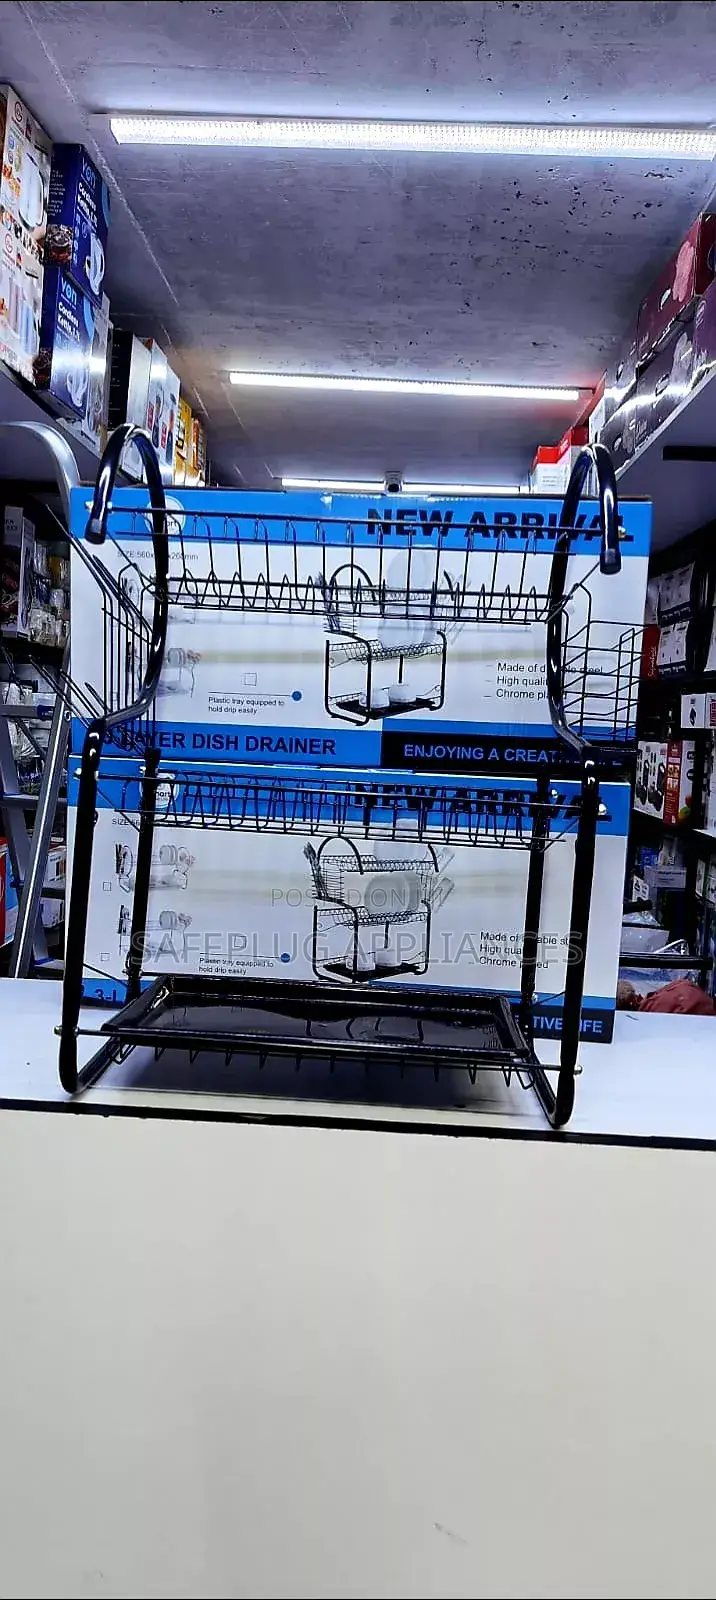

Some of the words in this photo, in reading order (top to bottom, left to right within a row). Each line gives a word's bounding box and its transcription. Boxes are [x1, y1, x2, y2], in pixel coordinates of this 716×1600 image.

[61, 277, 77, 305] von
[58, 301, 79, 328] Cordless
[367, 508, 454, 538] NEW
[497, 662, 525, 673] Made
[527, 662, 539, 673] of
[496, 675, 519, 687] High
[496, 688, 535, 700] Chrome
[208, 696, 231, 704] Plastic
[232, 697, 244, 706] tray
[246, 698, 277, 707] equipped
[208, 705, 223, 713] hold
[223, 706, 237, 715] drip
[192, 732, 239, 751] DISH
[245, 735, 337, 756] DRAINER
[404, 744, 485, 761] ENJOYING
[487, 750, 500, 761] A
[480, 932, 507, 942] Made
[509, 933, 519, 942] of
[479, 943, 502, 955] High
[479, 956, 517, 968] Chrome
